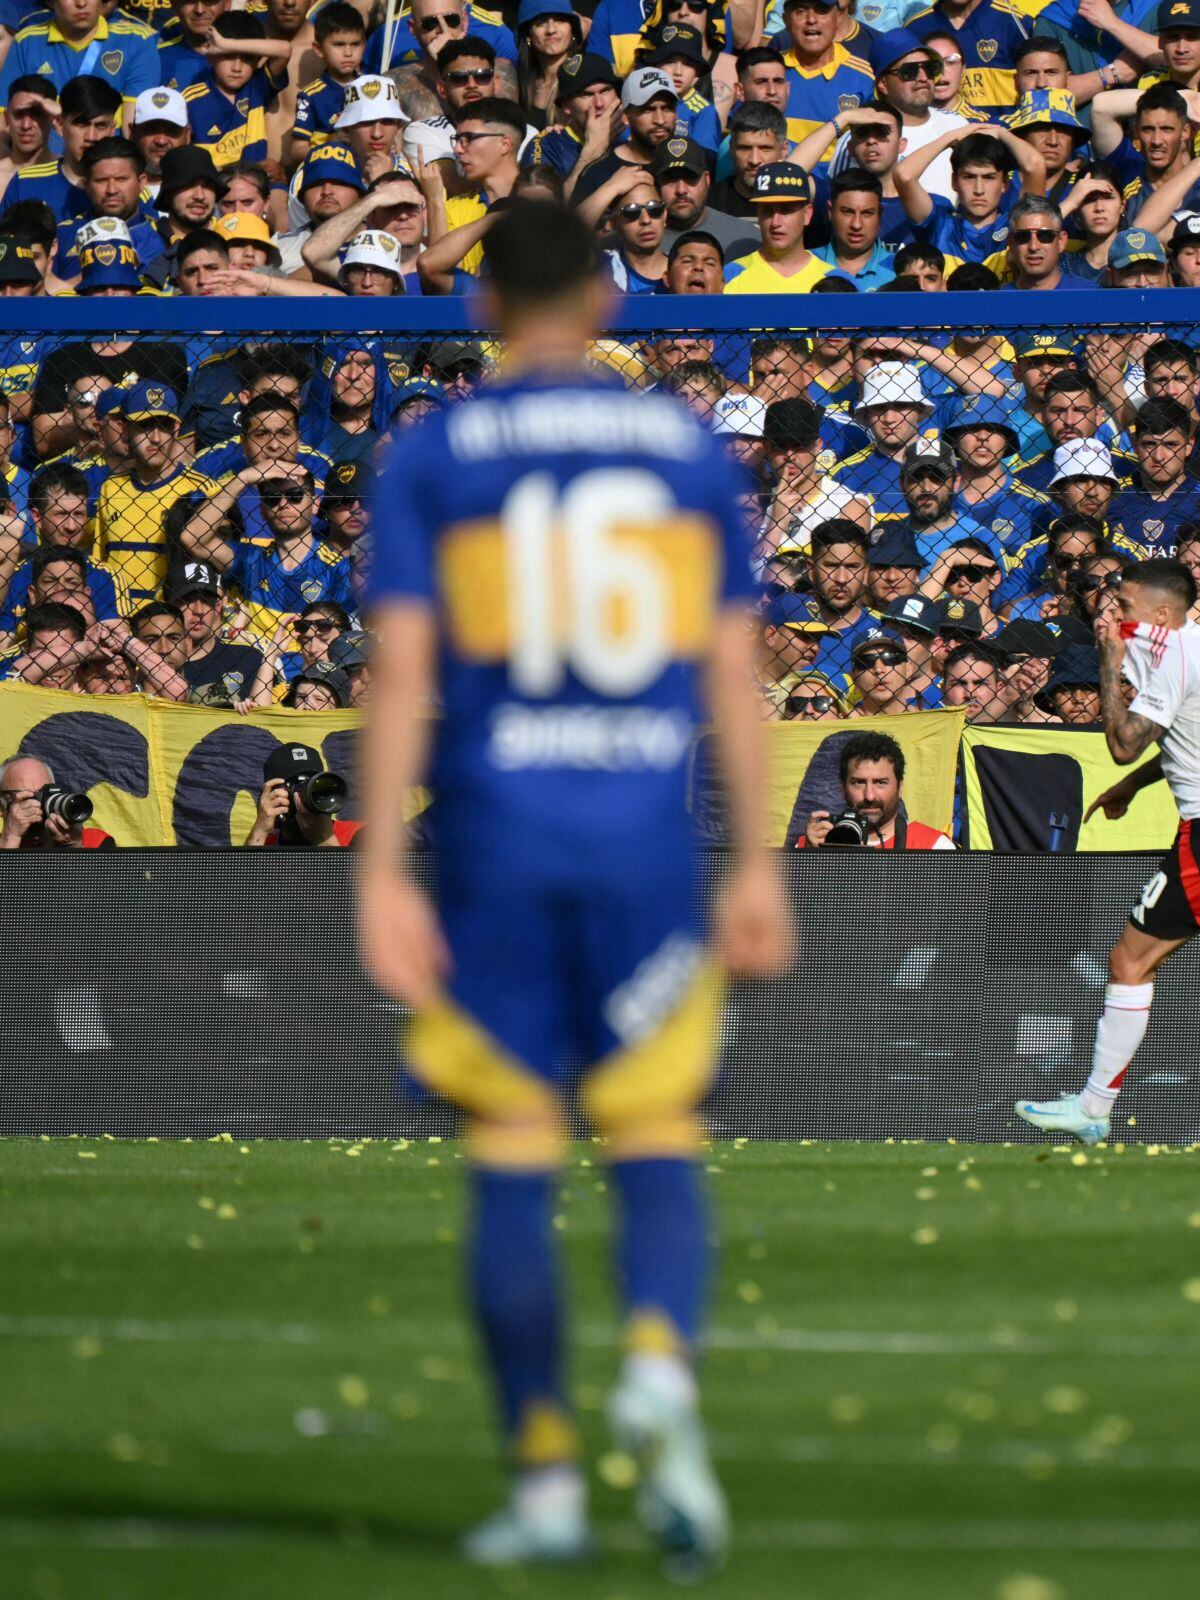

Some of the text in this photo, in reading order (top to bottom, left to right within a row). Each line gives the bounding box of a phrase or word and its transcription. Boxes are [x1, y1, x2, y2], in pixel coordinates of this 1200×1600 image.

[643, 71, 661, 80] NIKE
[310, 145, 356, 169] BOCA
[757, 175, 771, 191] 12
[503, 468, 676, 698] 16
